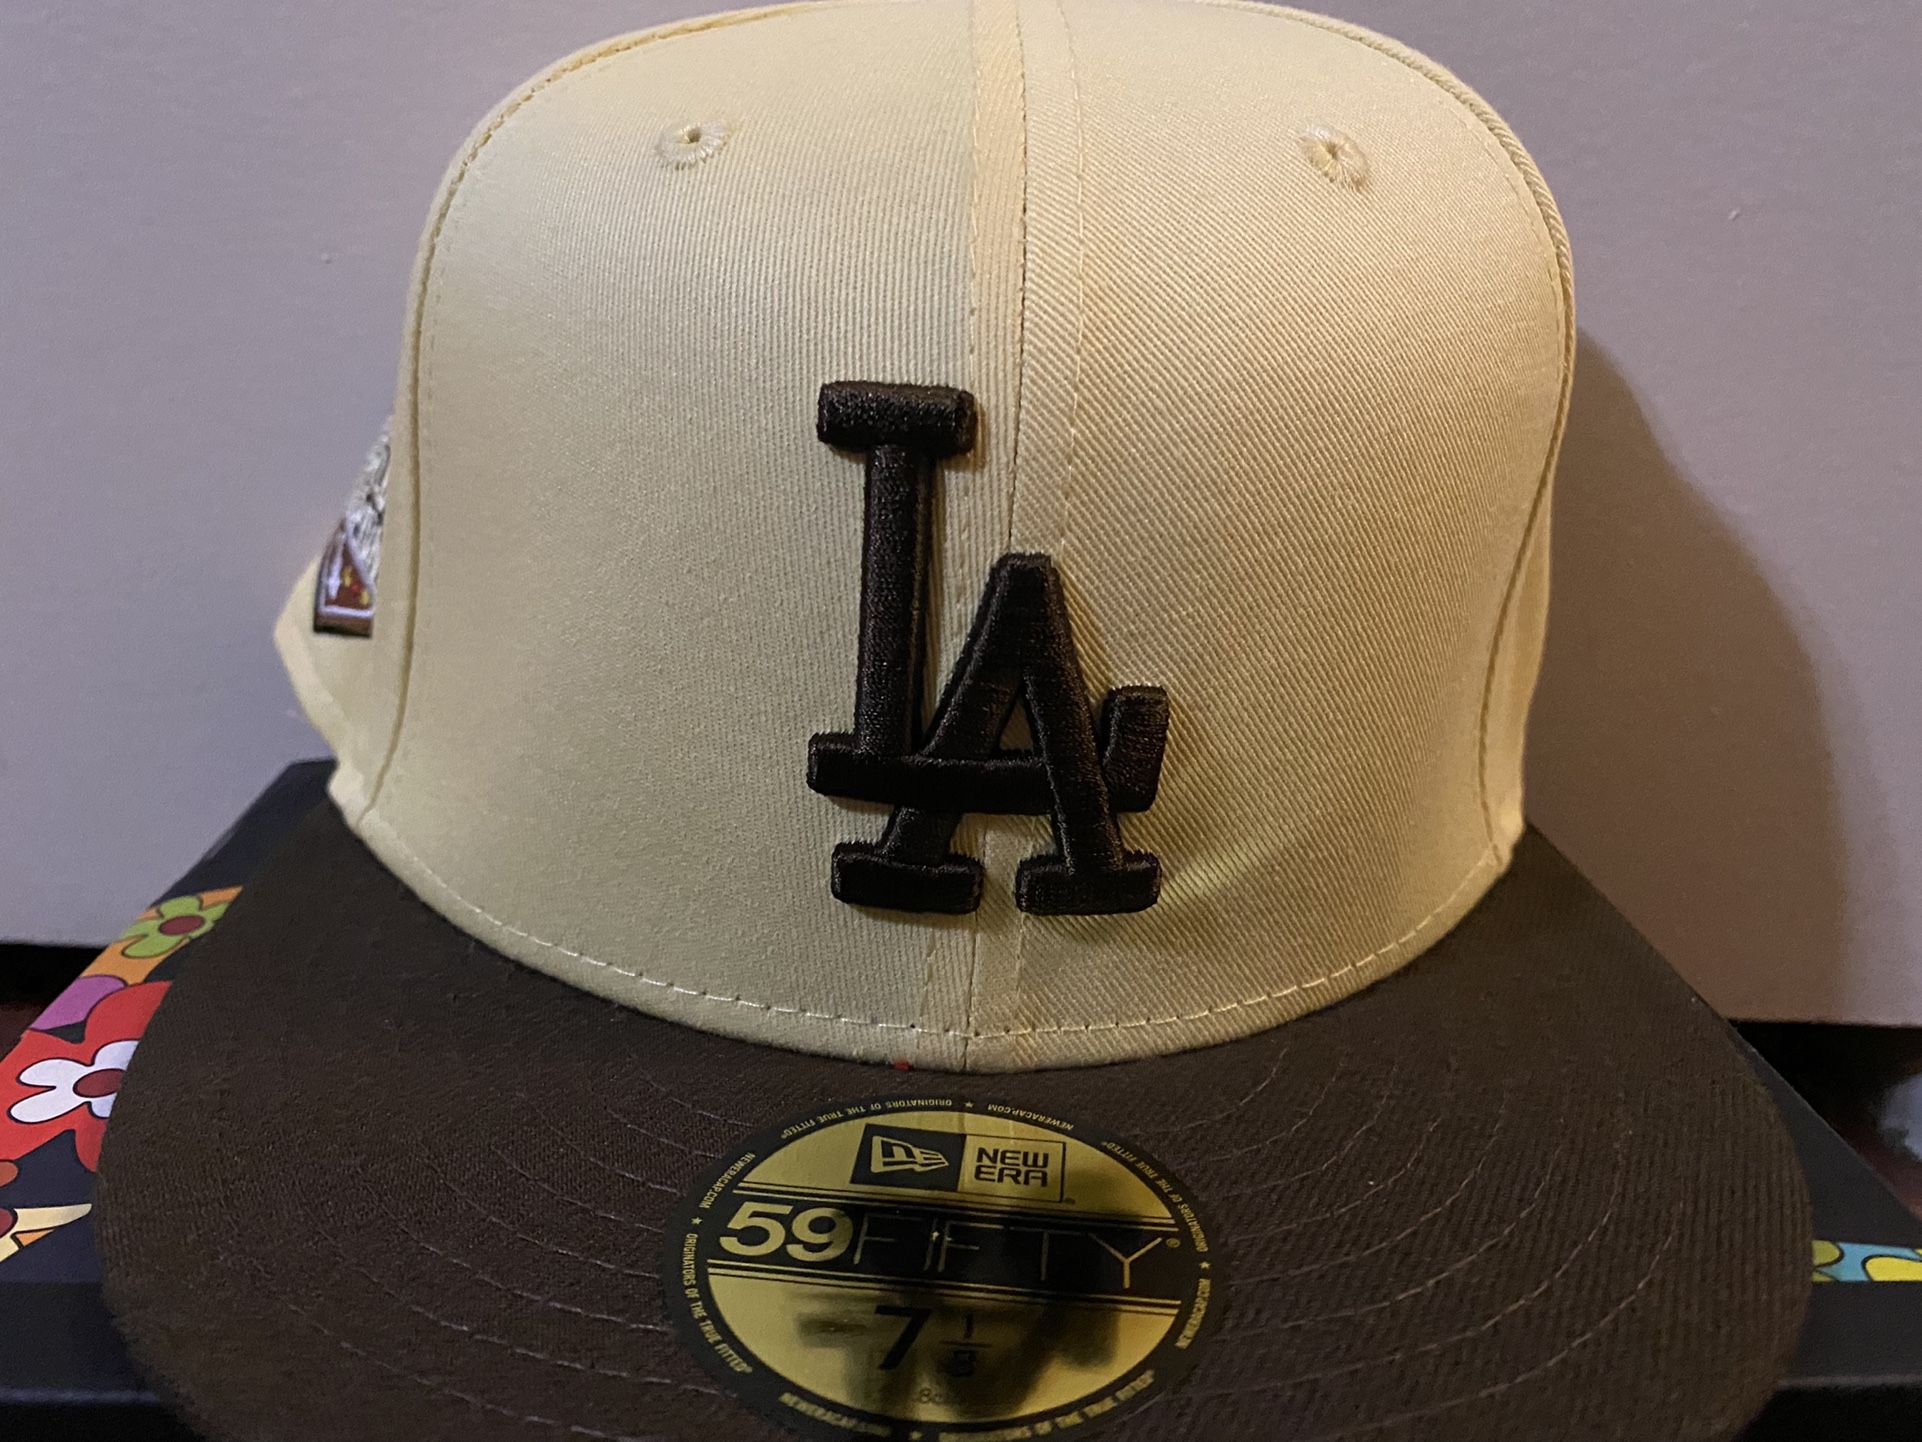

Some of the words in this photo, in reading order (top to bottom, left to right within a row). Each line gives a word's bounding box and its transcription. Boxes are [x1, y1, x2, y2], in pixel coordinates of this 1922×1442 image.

[806, 380, 1170, 915] LA
[847, 1105, 867, 1117] THE
[870, 1102, 883, 1112] OF
[886, 1098, 953, 1109] ORIGINATORS
[818, 1110, 844, 1124] TRUE
[987, 1103, 1075, 1131] NEWERACAP.COM
[975, 1146, 1049, 1169] NEW
[698, 1151, 756, 1209] NEWERACAP.COM
[973, 1163, 1048, 1187] ERA
[682, 1232, 699, 1286] ORIGINATORS
[684, 1286, 700, 1299] OF
[689, 1300, 708, 1319] THE
[699, 1320, 722, 1344] TRUE
[874, 1304, 932, 1370] 7
